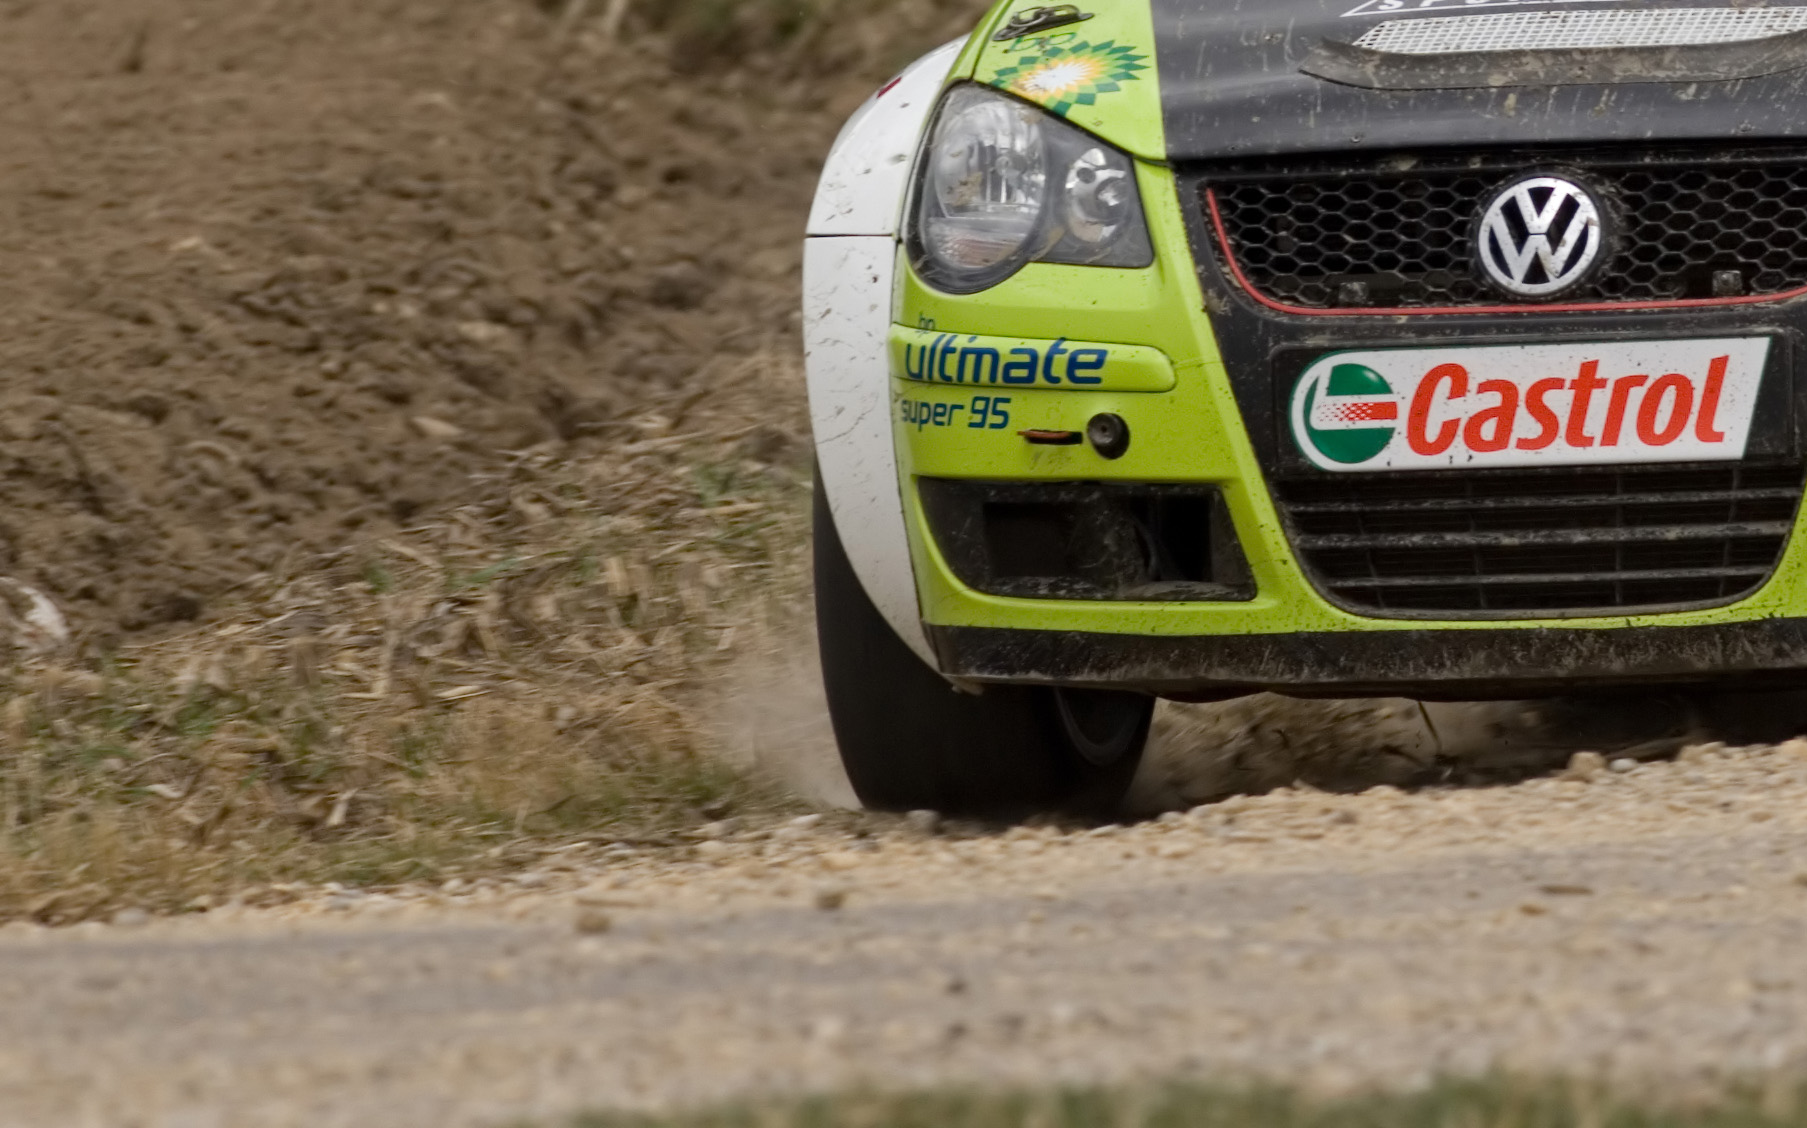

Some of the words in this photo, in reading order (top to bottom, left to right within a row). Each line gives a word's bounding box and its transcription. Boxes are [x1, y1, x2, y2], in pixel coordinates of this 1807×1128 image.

[905, 333, 1108, 384] ultimate
[902, 398, 964, 432] super
[968, 396, 1011, 429] 95
[1406, 355, 1730, 456] Castrol
